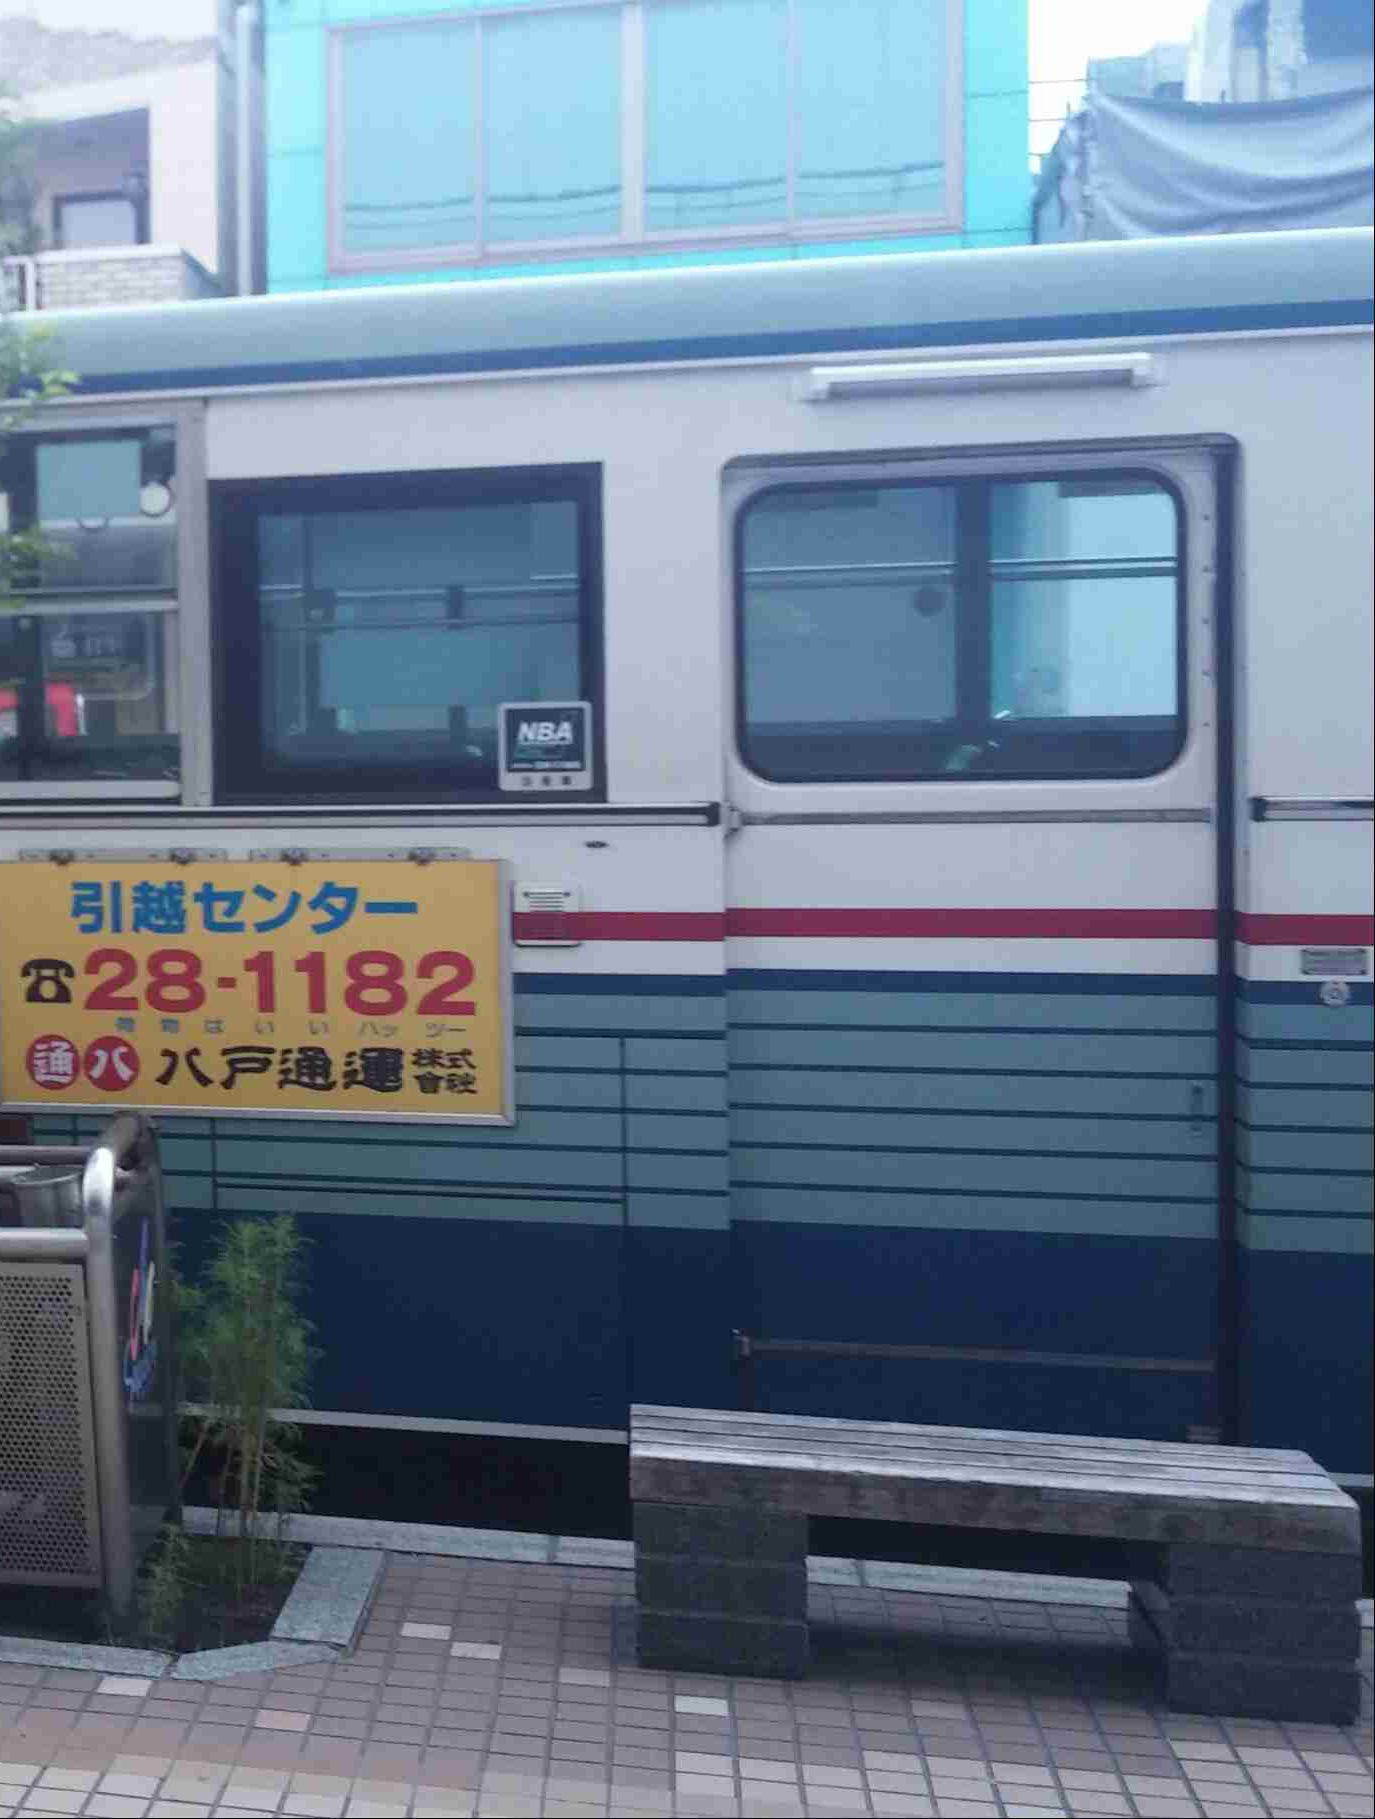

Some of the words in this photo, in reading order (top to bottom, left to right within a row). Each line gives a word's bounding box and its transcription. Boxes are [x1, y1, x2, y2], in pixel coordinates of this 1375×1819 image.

[518, 721, 574, 744] NBA
[70, 881, 418, 934] 引越センター
[83, 948, 476, 1016] 28-1182
[34, 1041, 74, 1083] 通
[90, 1046, 134, 1081] 八
[155, 1046, 404, 1092] 八戸通運
